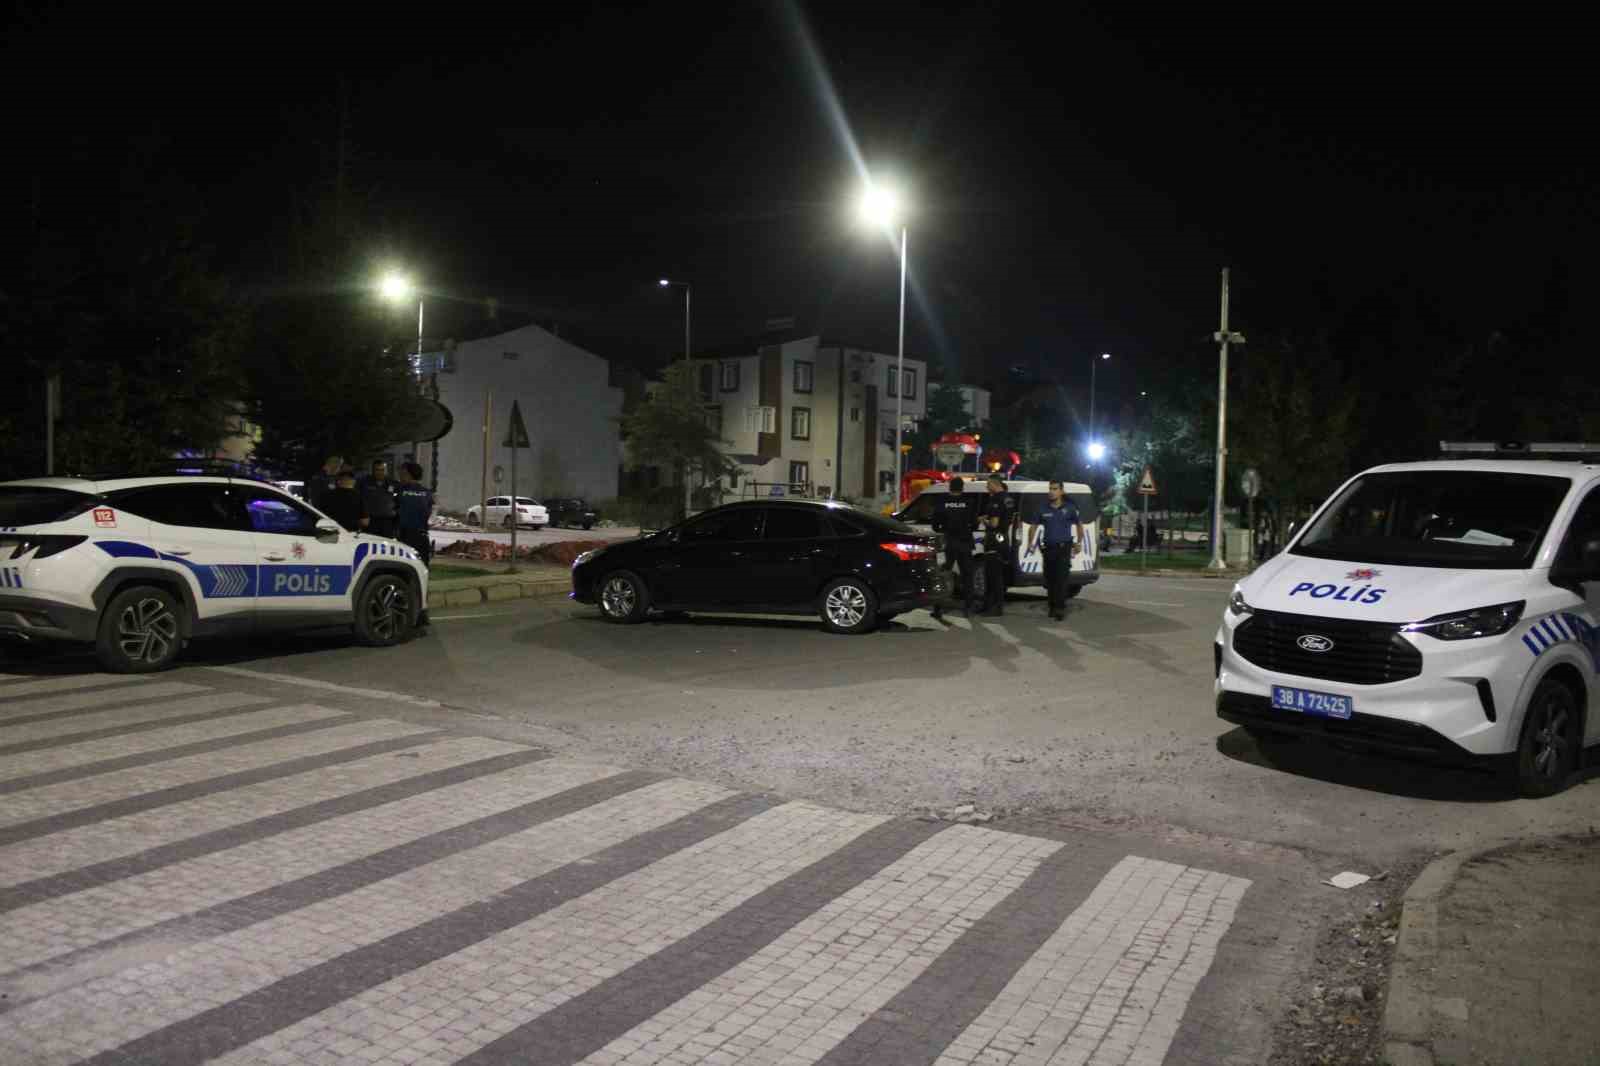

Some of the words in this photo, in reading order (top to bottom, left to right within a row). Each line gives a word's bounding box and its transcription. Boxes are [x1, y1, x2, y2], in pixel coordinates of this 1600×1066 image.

[95, 511, 113, 521] 112
[274, 568, 330, 592] POLİS
[1289, 584, 1387, 603] POLİS
[1301, 636, 1329, 650] Ford
[1280, 689, 1294, 705] 38
[1297, 692, 1304, 707] A
[1308, 693, 1346, 713] 72425
